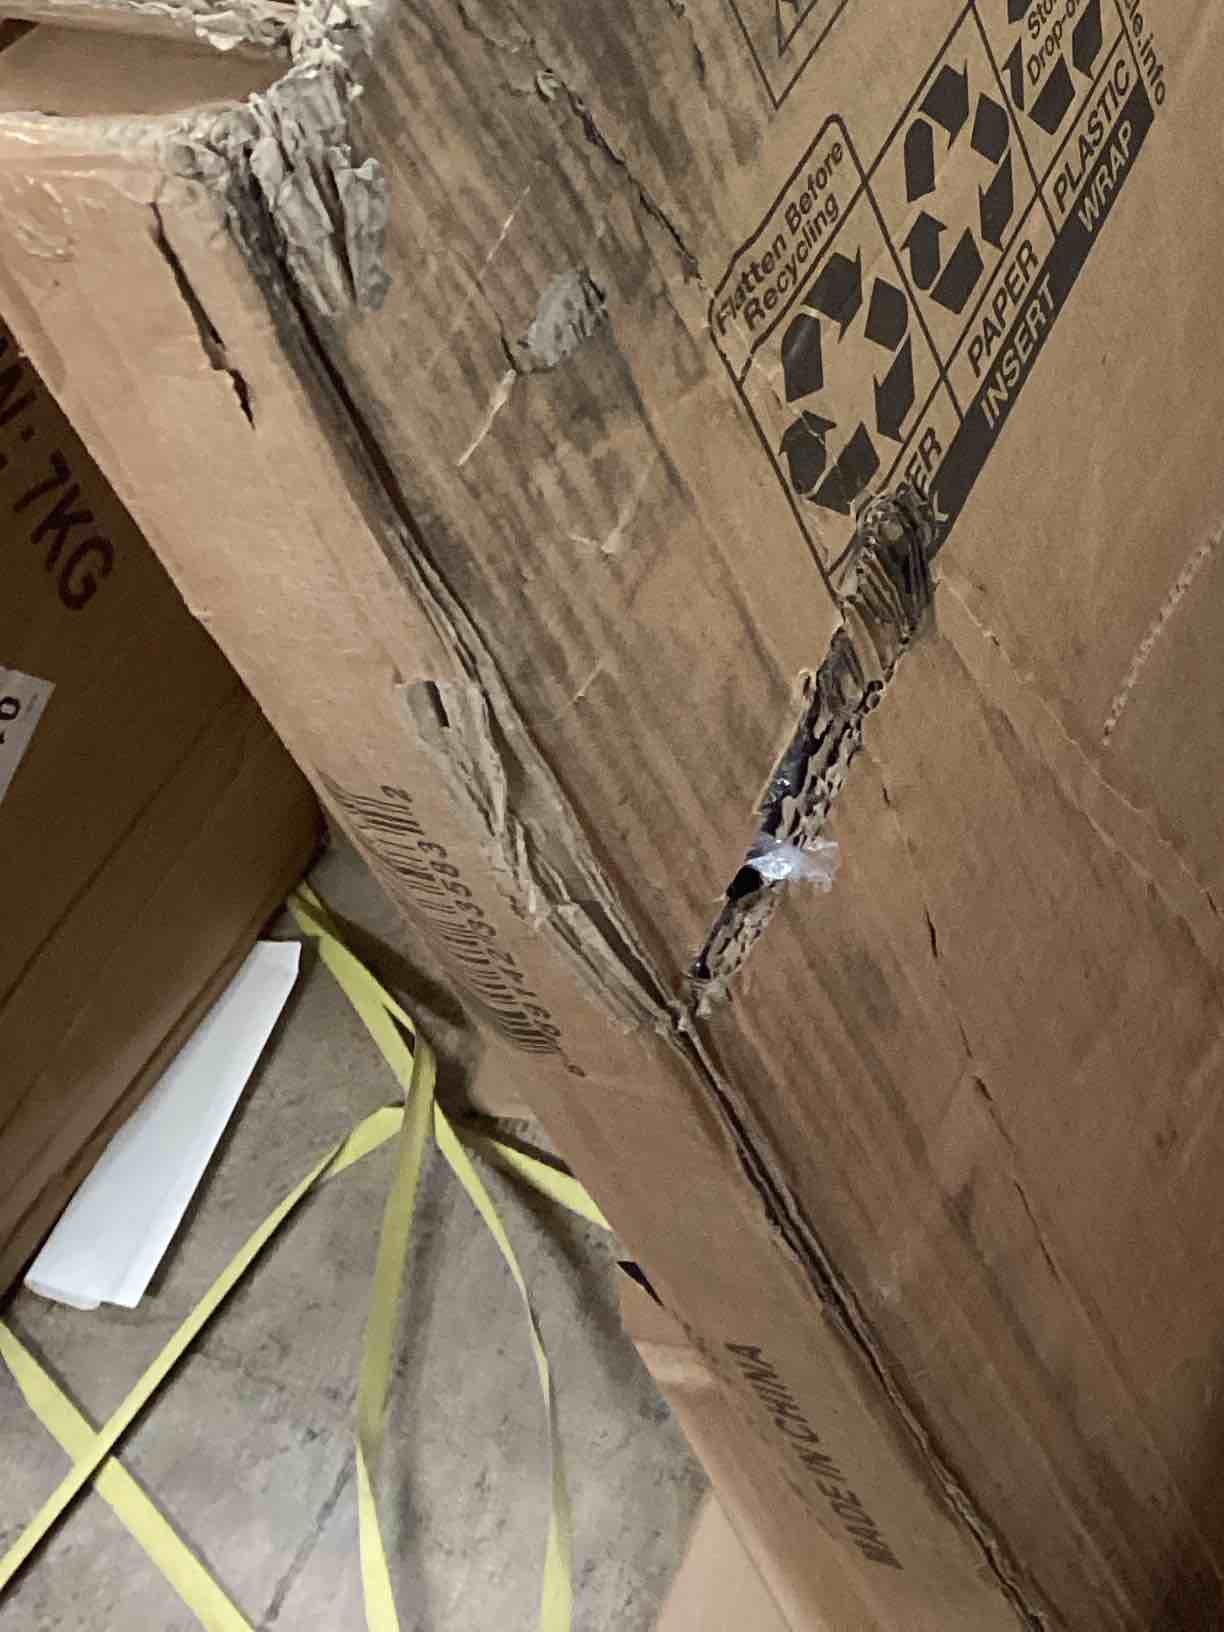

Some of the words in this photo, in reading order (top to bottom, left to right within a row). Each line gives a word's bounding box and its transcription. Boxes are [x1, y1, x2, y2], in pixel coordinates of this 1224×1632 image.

[1051, 58, 1130, 215] PLASTIC
[1076, 118, 1138, 234] WRAP
[715, 232, 788, 337] Flatten
[783, 140, 845, 236] Before
[742, 191, 841, 332] Recycling
[966, 238, 1040, 379] PAPER
[980, 271, 1057, 431] INSERT
[12, 447, 115, 612] 7KG
[723, 1341, 819, 1443] CHINA
[815, 1478, 905, 1571] MADE
